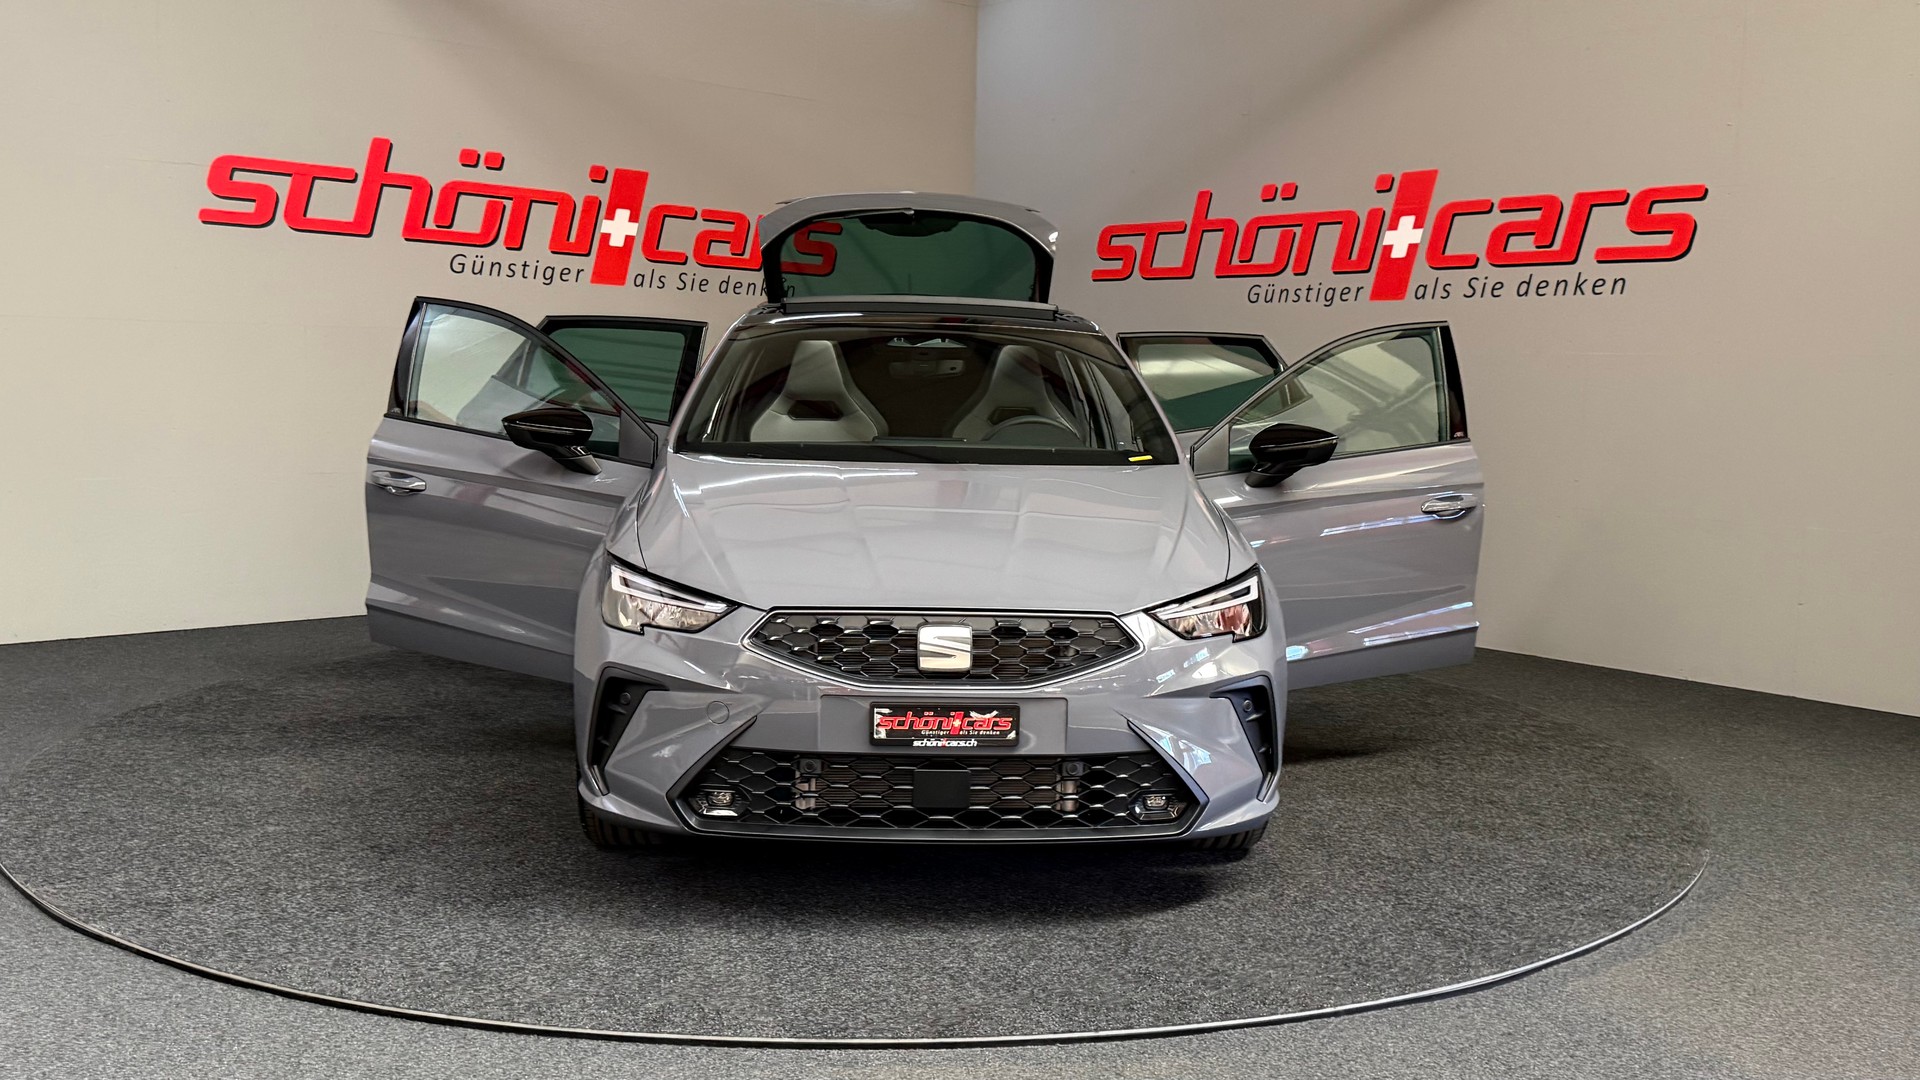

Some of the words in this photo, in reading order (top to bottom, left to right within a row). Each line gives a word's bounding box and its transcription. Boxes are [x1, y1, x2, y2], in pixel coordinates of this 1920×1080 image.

[1425, 184, 1709, 269] cars
[450, 253, 585, 285] Günstiger
[633, 268, 666, 289] als
[676, 272, 709, 292] Sie
[718, 275, 796, 299] denkn
[1247, 282, 1365, 307] Günstiger
[1414, 277, 1452, 300] als
[1463, 276, 1504, 298] Sie
[1516, 272, 1627, 297] denken
